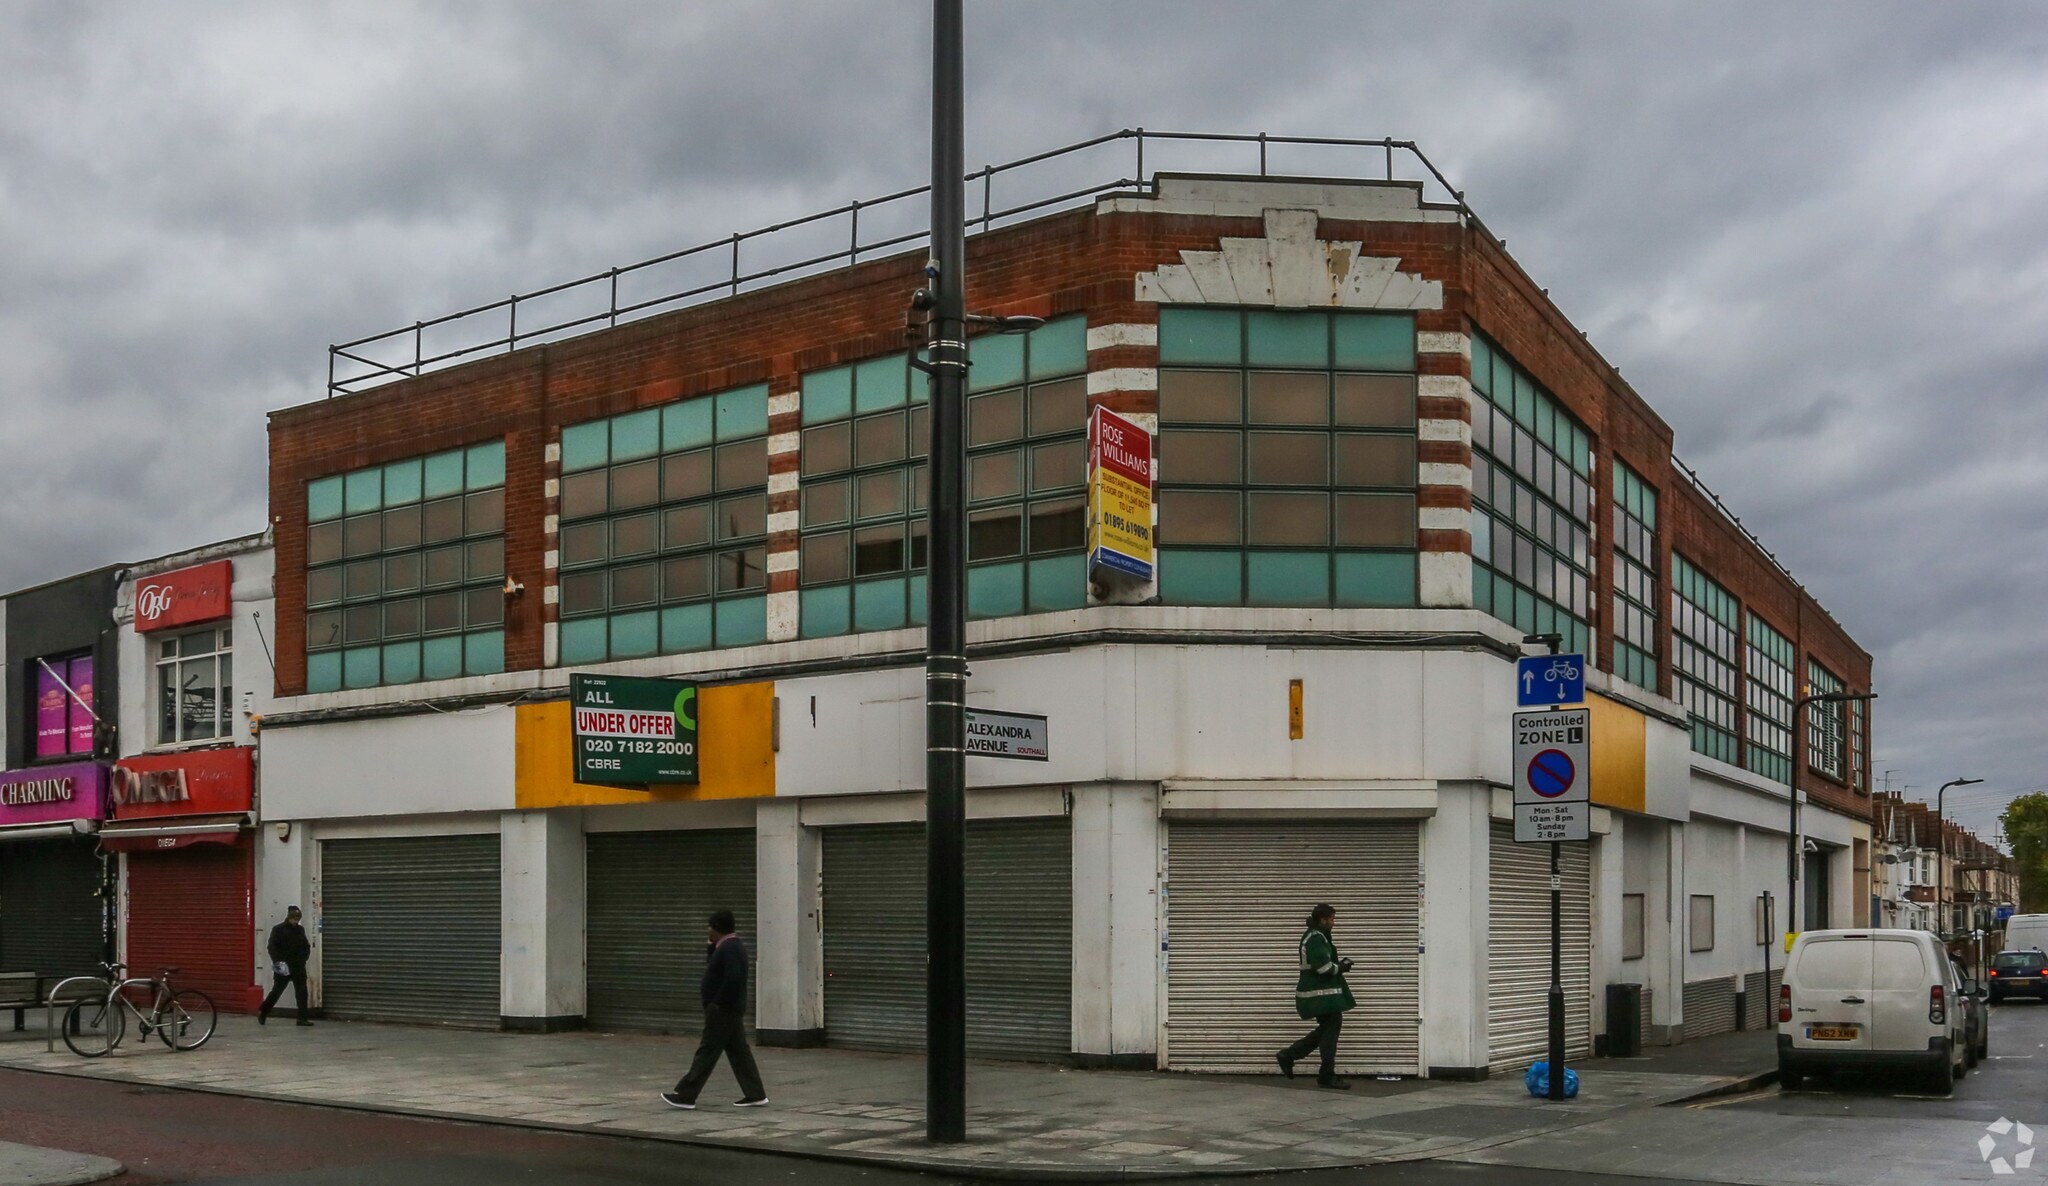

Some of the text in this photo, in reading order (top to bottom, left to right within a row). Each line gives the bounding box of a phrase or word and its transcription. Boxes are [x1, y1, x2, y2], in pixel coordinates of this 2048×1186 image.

[1102, 422, 1123, 447] ROSE
[1102, 440, 1147, 475] WILLIAMS
[1101, 483, 1117, 497] FLOOR
[1119, 501, 1134, 514] TO LET
[1104, 511, 1125, 531] 01895
[585, 691, 614, 704] ALL
[578, 711, 673, 735] UNDER OFFER
[1519, 714, 1584, 728] Controlled
[966, 723, 1032, 739] ALEXANDRA
[1519, 728, 1582, 744] ZONE L
[585, 740, 693, 755] 020 7182 2000
[966, 738, 1046, 756] AVENUE SOUTHALL
[586, 758, 621, 770] CBRE
[0, 777, 71, 805] CHARMING
[112, 767, 190, 804] OMEGA
[1537, 823, 1566, 831] Sunday
